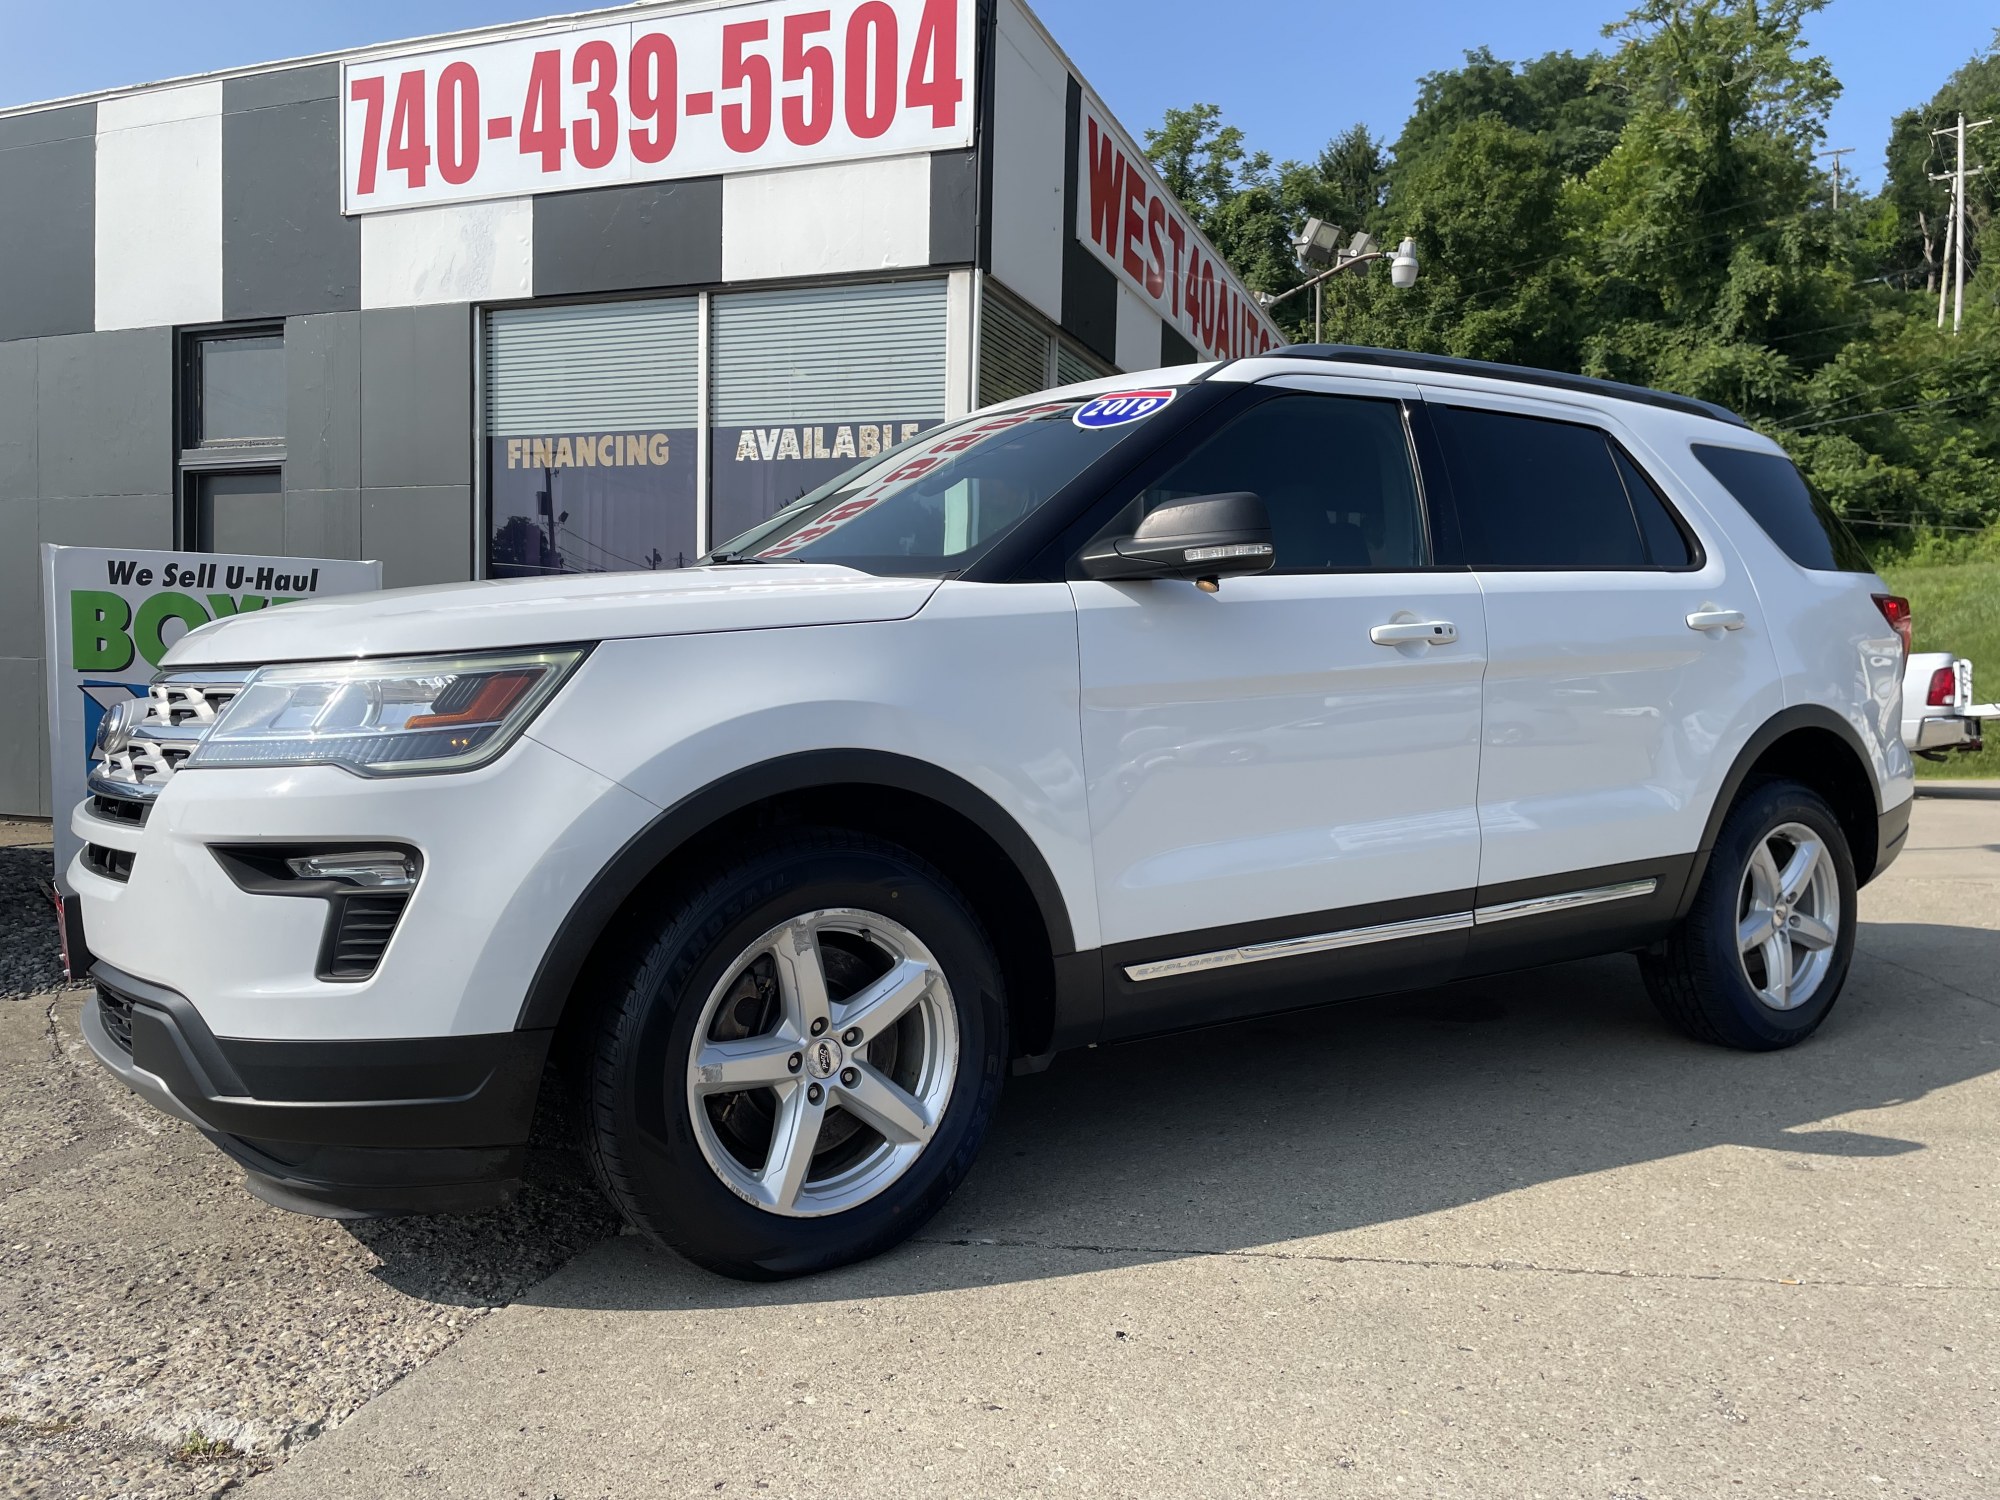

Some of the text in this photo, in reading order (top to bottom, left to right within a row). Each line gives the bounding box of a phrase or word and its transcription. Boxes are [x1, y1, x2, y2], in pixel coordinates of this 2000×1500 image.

[350, 0, 963, 196] 740-439-5504
[1082, 397, 1158, 417] 2019
[507, 433, 670, 469] FINANCING
[107, 560, 319, 592] We Sell U-Haul
[1136, 954, 1237, 976] EXPLORER
